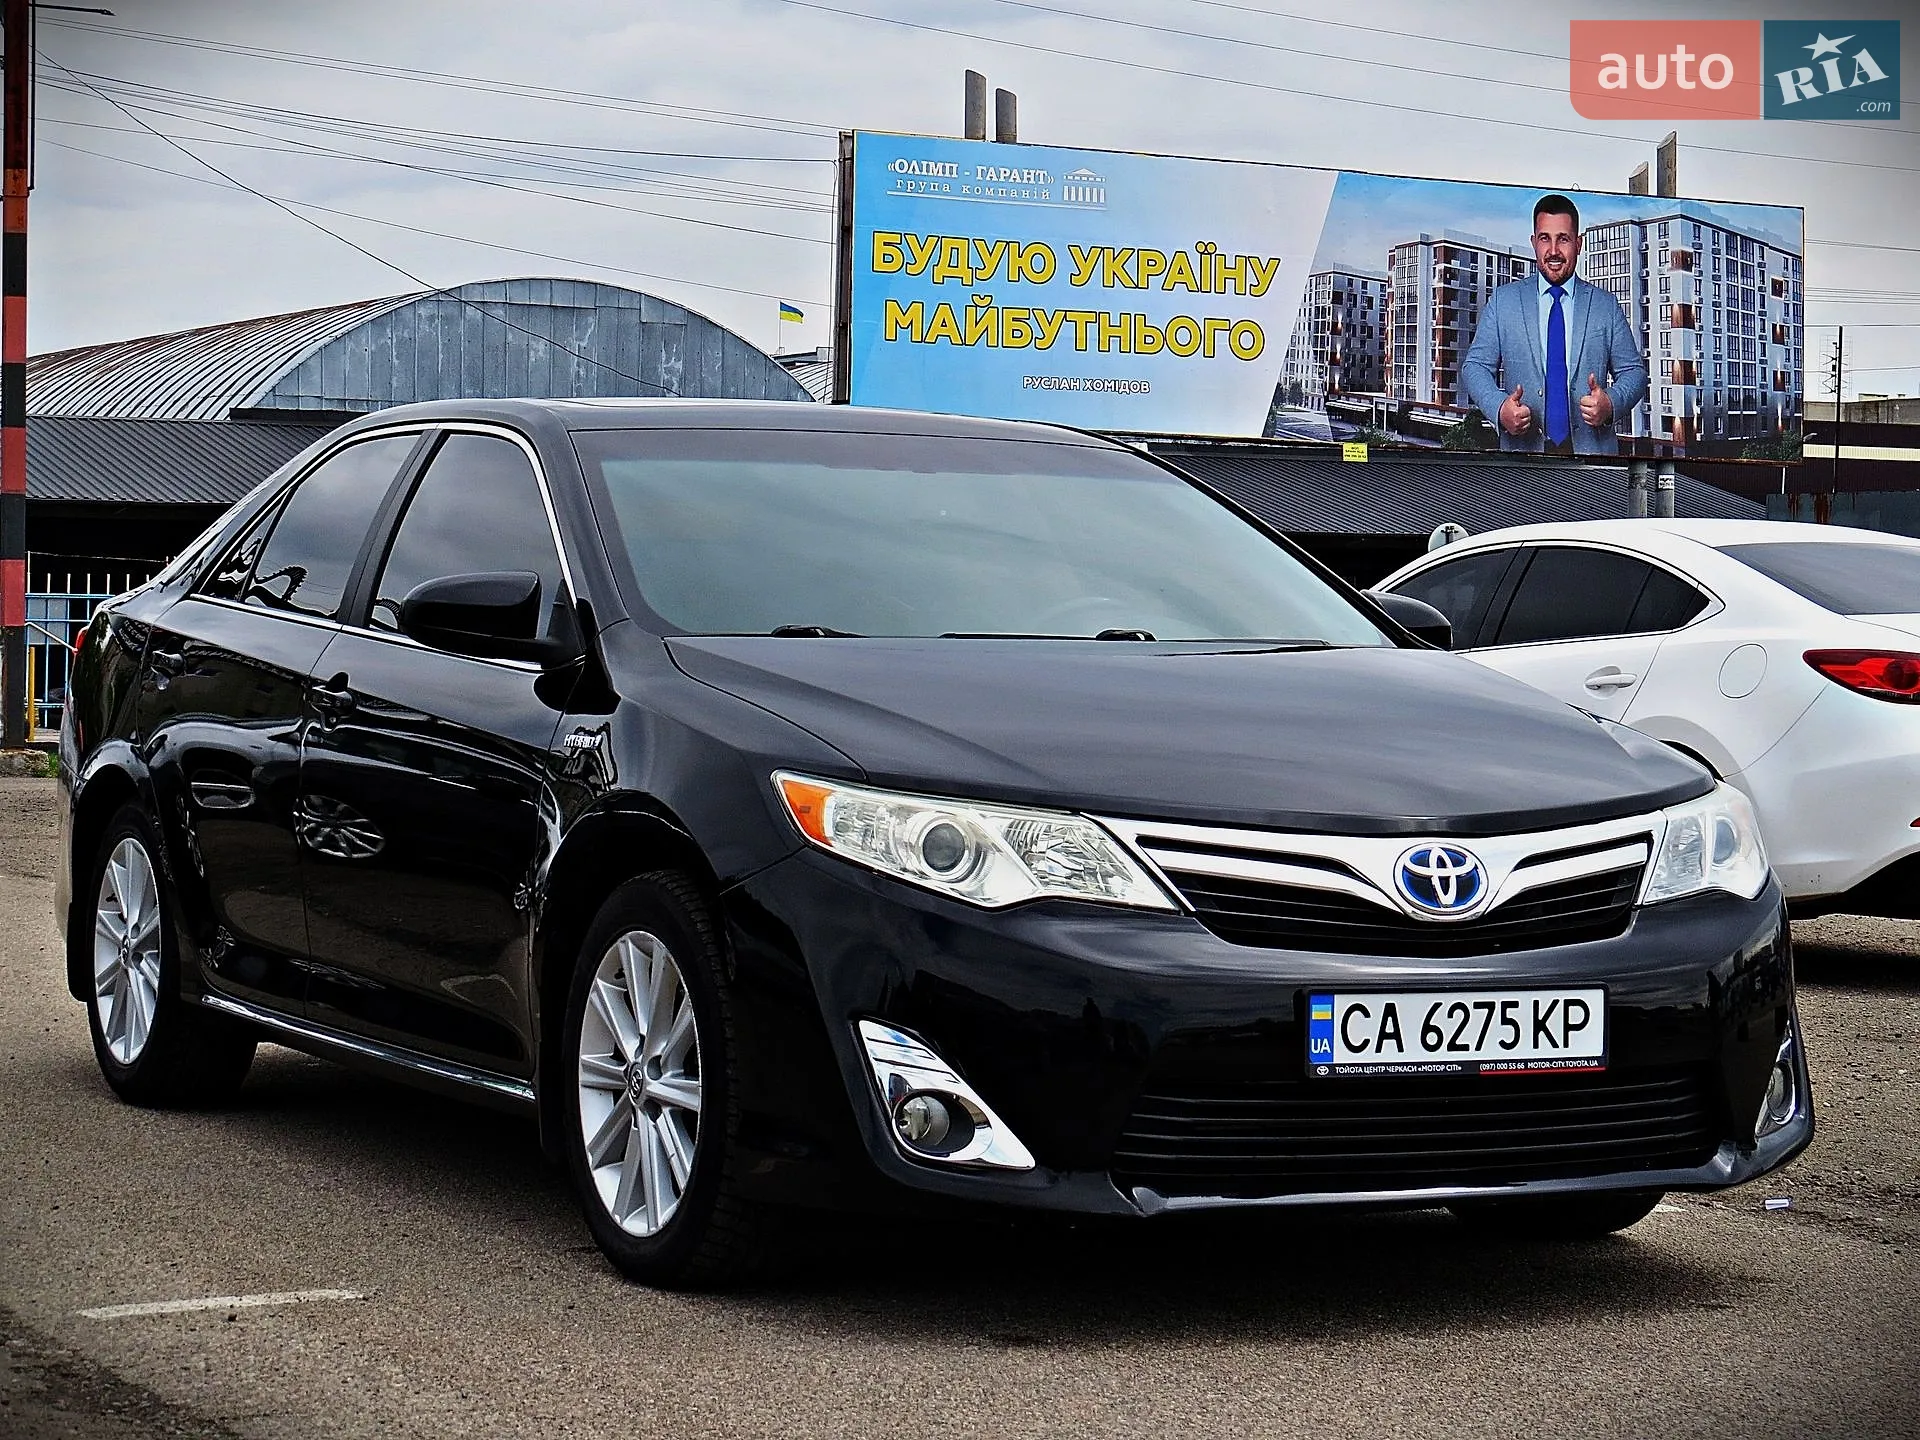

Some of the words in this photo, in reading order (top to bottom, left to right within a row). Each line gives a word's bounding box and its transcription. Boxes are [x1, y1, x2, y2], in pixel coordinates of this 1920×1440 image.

[896, 178, 951, 193] група
[962, 184, 1051, 200] компаній
[872, 230, 1058, 286] БУДУЮ
[1067, 241, 1281, 297] УКРАЇНУ
[884, 294, 1267, 361] МАЙБУТНЬОГО
[1022, 375, 1081, 391] РУСЛАН
[1083, 378, 1151, 395] ХОМІДОВ
[1339, 1002, 1405, 1054] CA
[1419, 1000, 1521, 1052] 6275
[1531, 998, 1592, 1050] KP
[1311, 1038, 1332, 1054] UA
[1335, 1065, 1363, 1074] ТОЙОТА
[1363, 1065, 1386, 1074] ЦЕНТР
[1386, 1064, 1418, 1073] ЧЕРКАСИ
